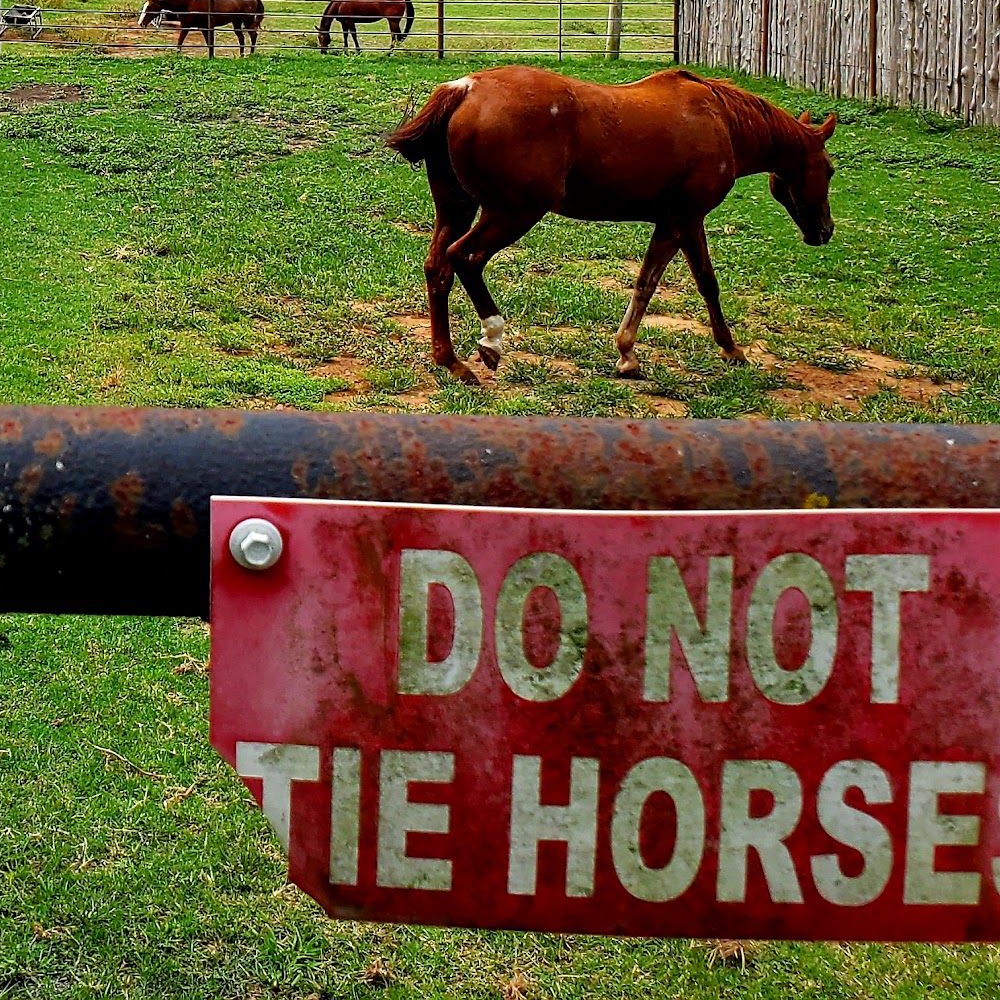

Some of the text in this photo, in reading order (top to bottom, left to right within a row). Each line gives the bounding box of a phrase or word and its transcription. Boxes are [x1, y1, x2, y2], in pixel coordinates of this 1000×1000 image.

[398, 548, 930, 706] DO NOT
[235, 742, 1000, 907] TIE HORSE
